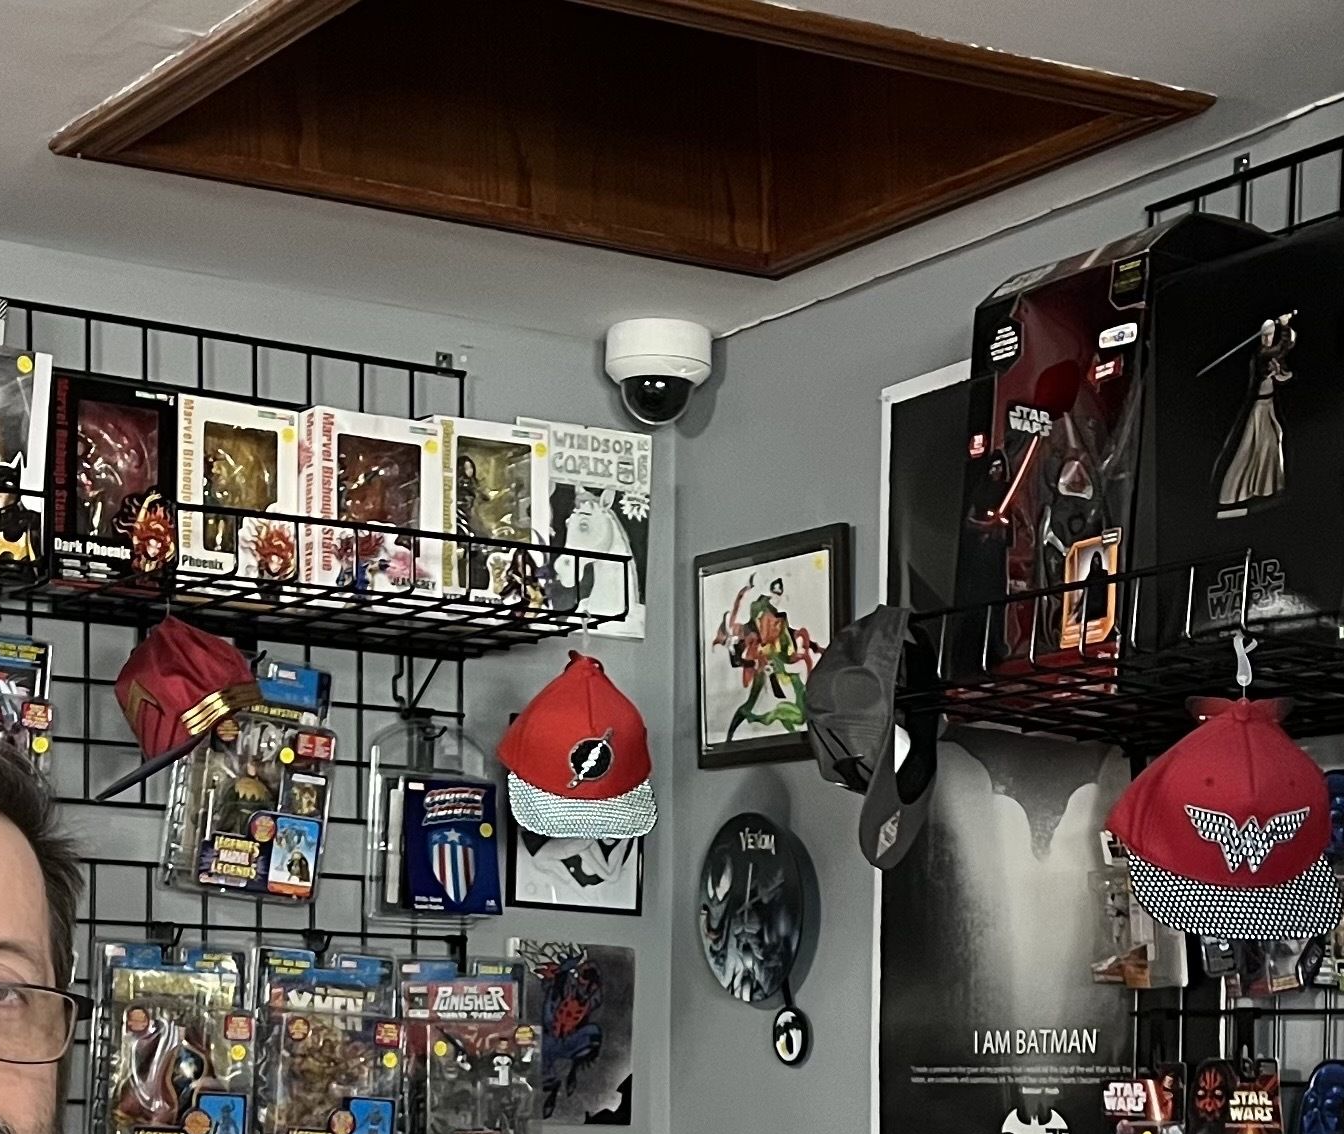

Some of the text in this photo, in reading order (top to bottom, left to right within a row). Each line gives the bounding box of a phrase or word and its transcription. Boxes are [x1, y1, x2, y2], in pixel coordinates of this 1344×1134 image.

[1009, 405, 1053, 426] STAR
[321, 412, 336, 460] Marvel
[552, 430, 634, 456] WINDSOR
[54, 537, 131, 559] Dark Phoenix
[181, 554, 223, 571] Phoenix
[1208, 559, 1285, 594] STAR
[739, 827, 776, 855] VENOM
[432, 986, 510, 1011] PUNISHER
[974, 1029, 1098, 1054] I AM BATMAN
[1103, 1082, 1146, 1100] STAR
[1229, 1090, 1273, 1106] STAR
[1103, 1096, 1146, 1112] WARS
[1229, 1106, 1274, 1122] WARS
